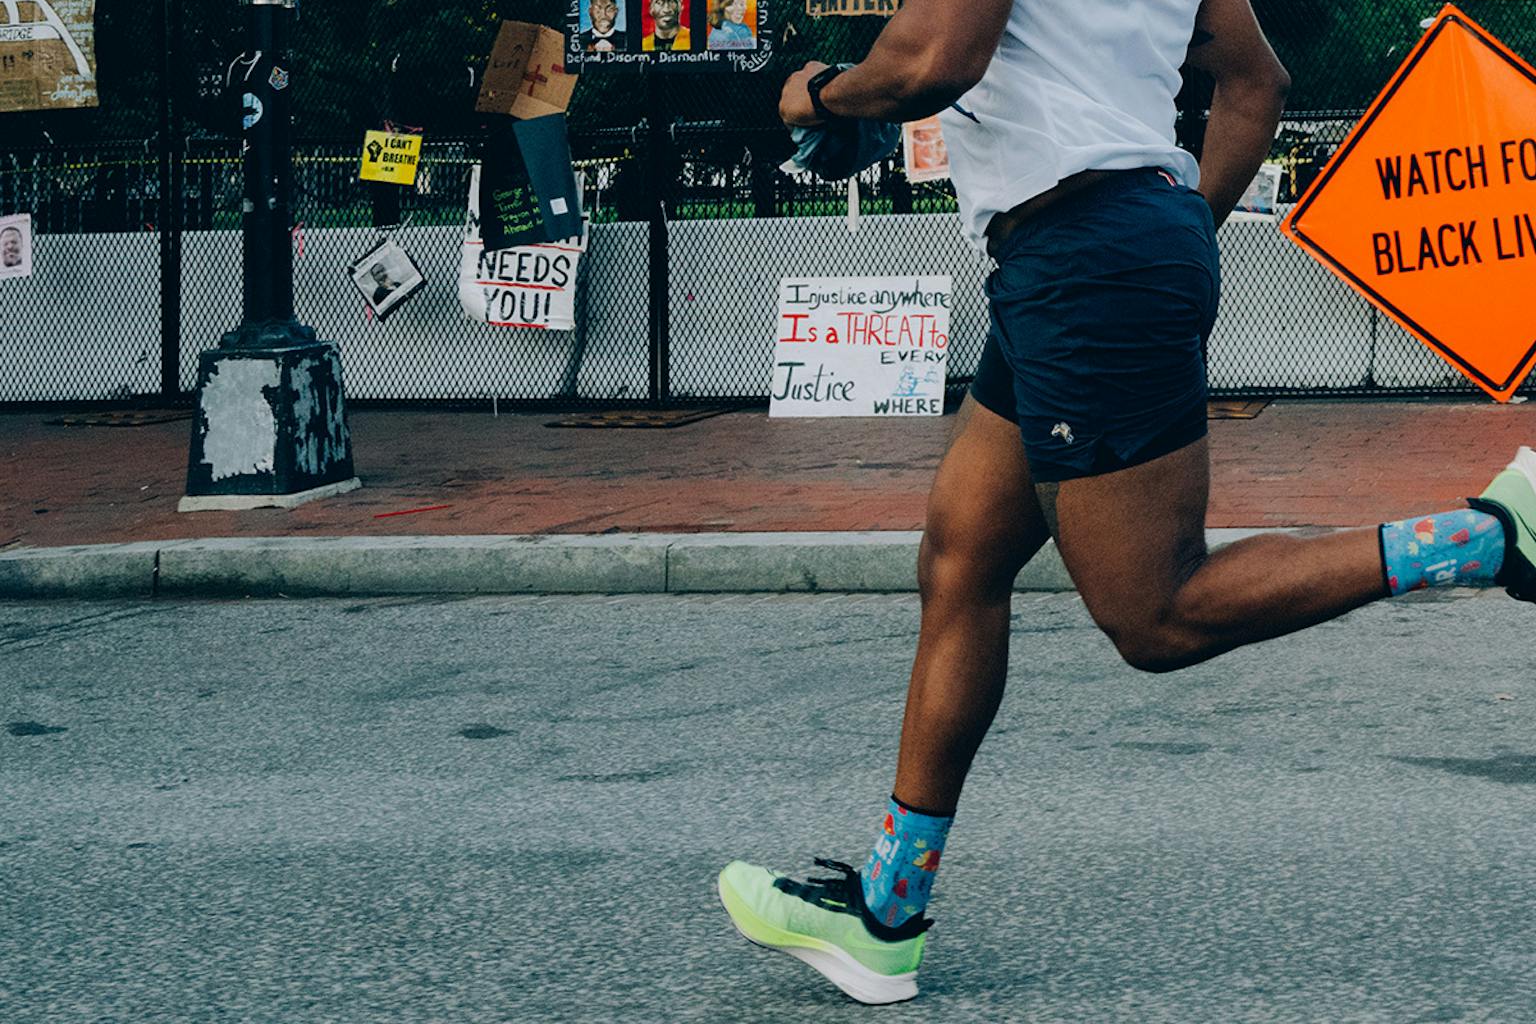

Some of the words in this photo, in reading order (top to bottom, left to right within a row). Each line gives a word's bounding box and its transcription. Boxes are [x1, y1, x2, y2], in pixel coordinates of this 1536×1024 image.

[565, 22, 580, 52] end
[382, 152, 417, 166] BREATHE
[1375, 144, 1489, 200] WATCH
[1372, 220, 1483, 276] BLACK
[477, 249, 571, 288] NEEDS
[484, 287, 551, 323] YOU!
[785, 285, 867, 311] Injustice
[869, 279, 951, 314] anywhere
[779, 314, 817, 343] Is
[825, 326, 839, 344] a
[836, 311, 935, 348] THREAT
[928, 319, 949, 349] to
[880, 349, 946, 365] EVERY
[772, 362, 856, 403] Justice
[873, 398, 942, 414] WHERE
